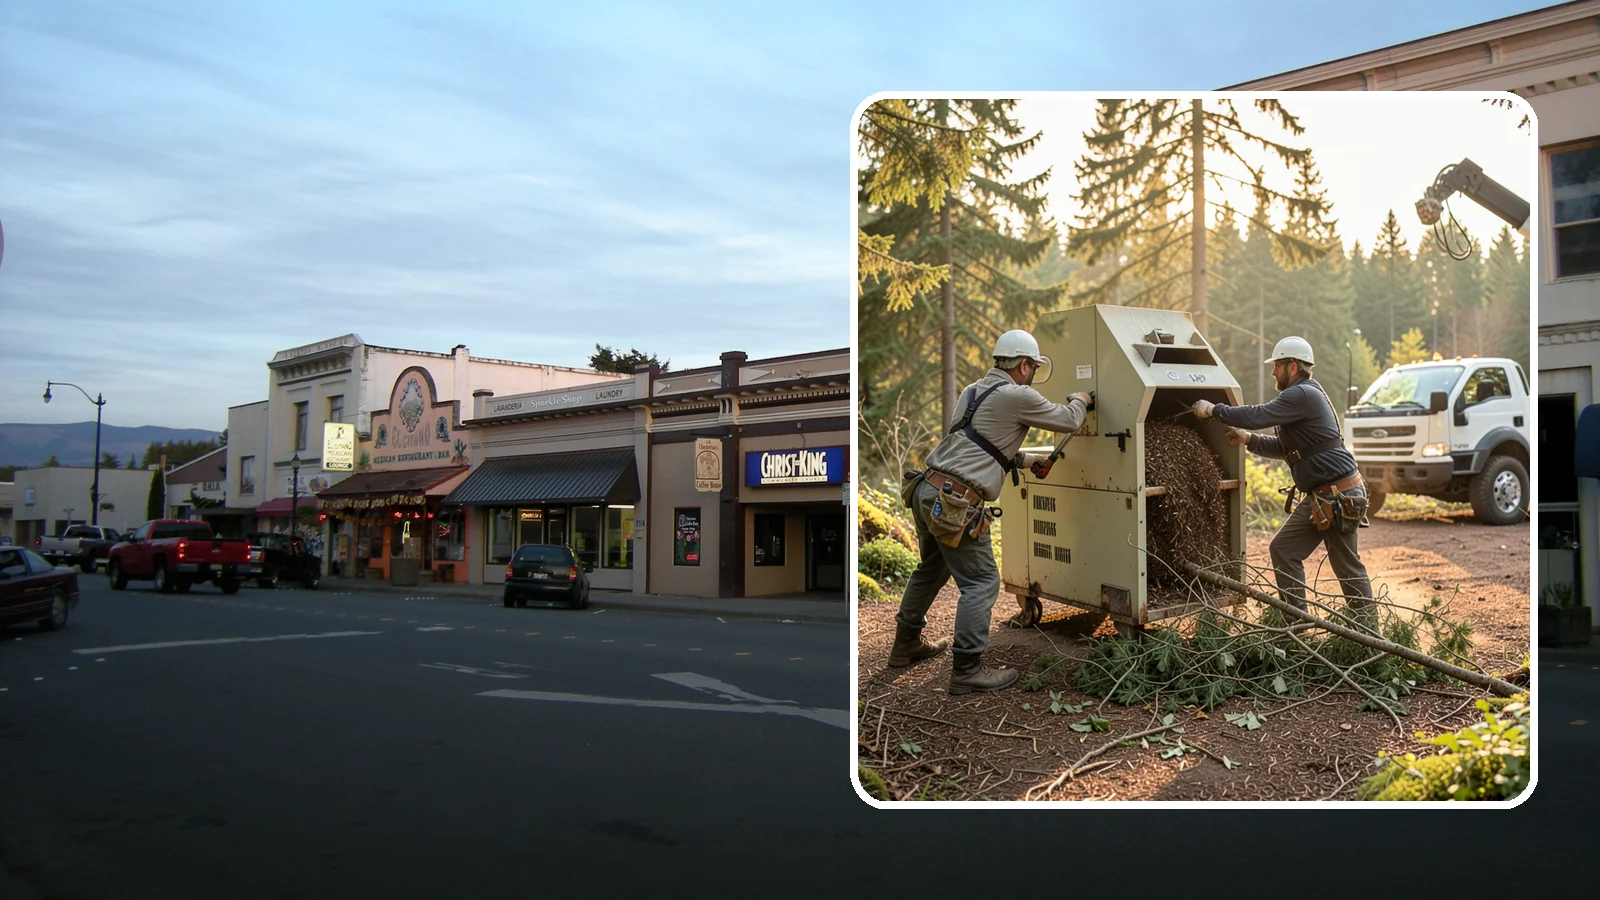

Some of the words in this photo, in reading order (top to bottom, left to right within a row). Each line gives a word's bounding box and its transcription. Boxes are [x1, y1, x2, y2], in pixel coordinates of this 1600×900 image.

[493, 402, 522, 412] LAVANDERIA
[531, 396, 560, 409] Sparkle
[562, 394, 582, 406] Shop
[595, 389, 623, 400] LAUNDRY
[373, 454, 396, 464] MEXICAN
[397, 451, 434, 462] RESTAURANT
[437, 450, 450, 459] BAR
[760, 452, 797, 478] CHRIST
[799, 450, 827, 477] KING
